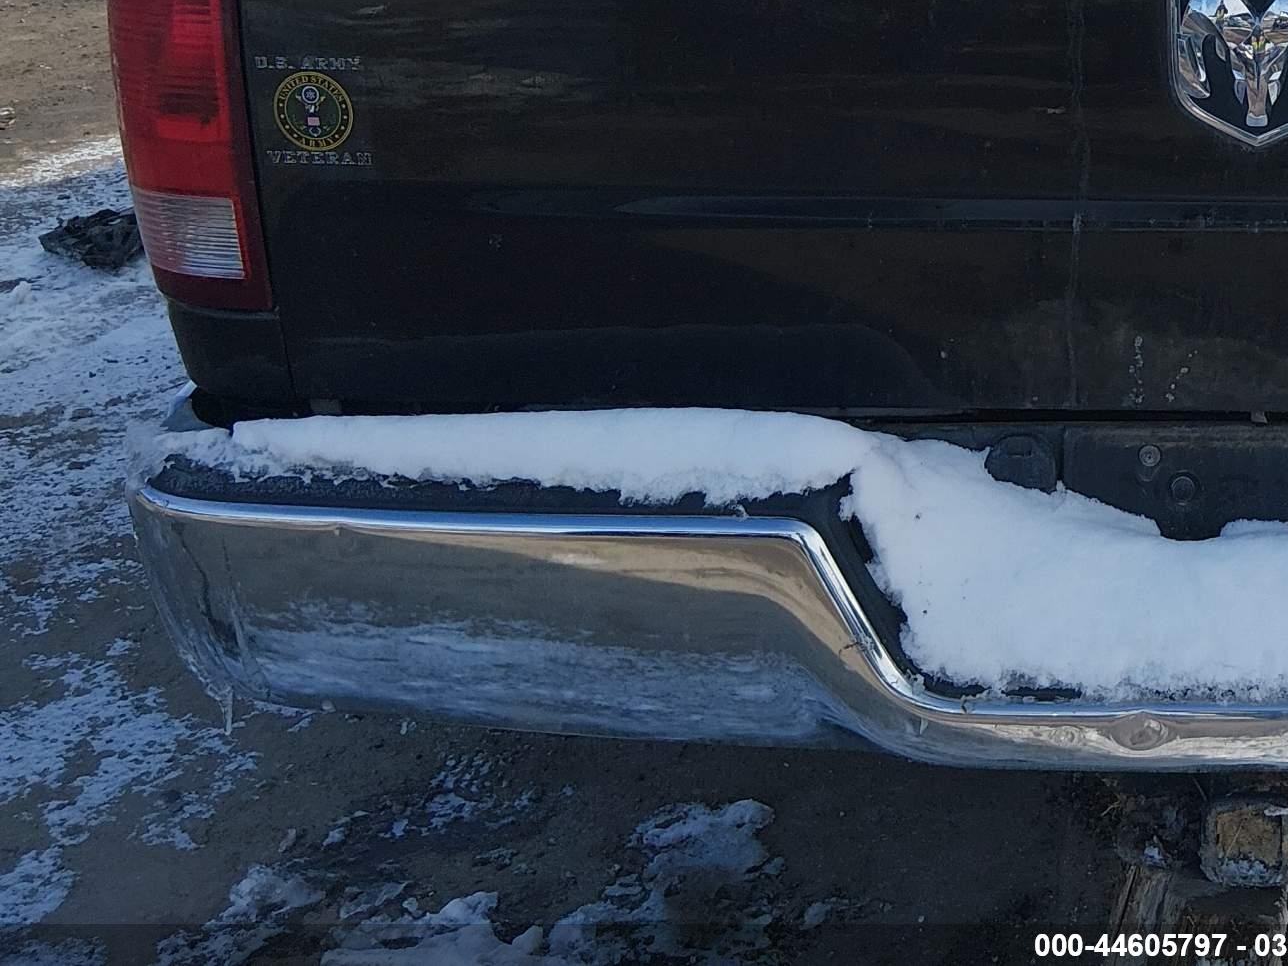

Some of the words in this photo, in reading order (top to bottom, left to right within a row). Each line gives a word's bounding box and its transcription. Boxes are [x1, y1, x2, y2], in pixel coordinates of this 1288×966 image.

[300, 56, 361, 71] ARMY
[279, 75, 309, 101] UNITED
[310, 75, 345, 102] STATES
[299, 137, 336, 148] ARMY
[266, 150, 374, 166] VETERAN
